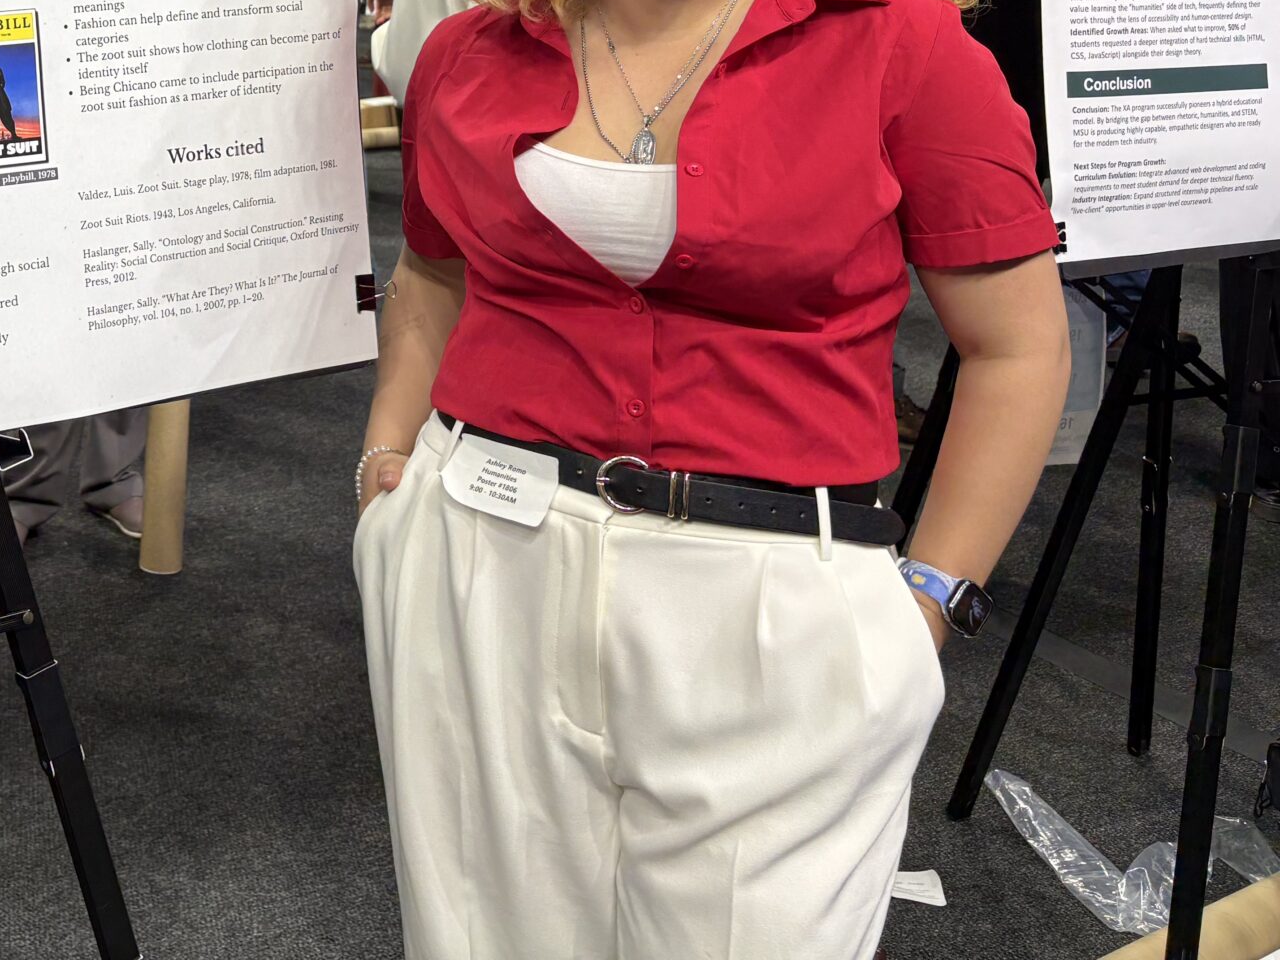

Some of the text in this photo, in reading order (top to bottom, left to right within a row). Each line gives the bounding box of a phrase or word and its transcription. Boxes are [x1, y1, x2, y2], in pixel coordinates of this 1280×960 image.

[1083, 75, 1151, 91] Conclusion
[6, 140, 39, 155] SUIT
[166, 136, 264, 164] Works cited
[2, 172, 36, 185] playbill,
[38, 170, 56, 179] 1978
[80, 195, 276, 230] Zoot Suit Riots. 1943, Los Angeles, California.
[481, 466, 517, 483] Humanities
[485, 458, 526, 474] Ashley Romo
[476, 475, 517, 493] Poster #1806
[469, 483, 516, 504] 9:00 10:30AM
